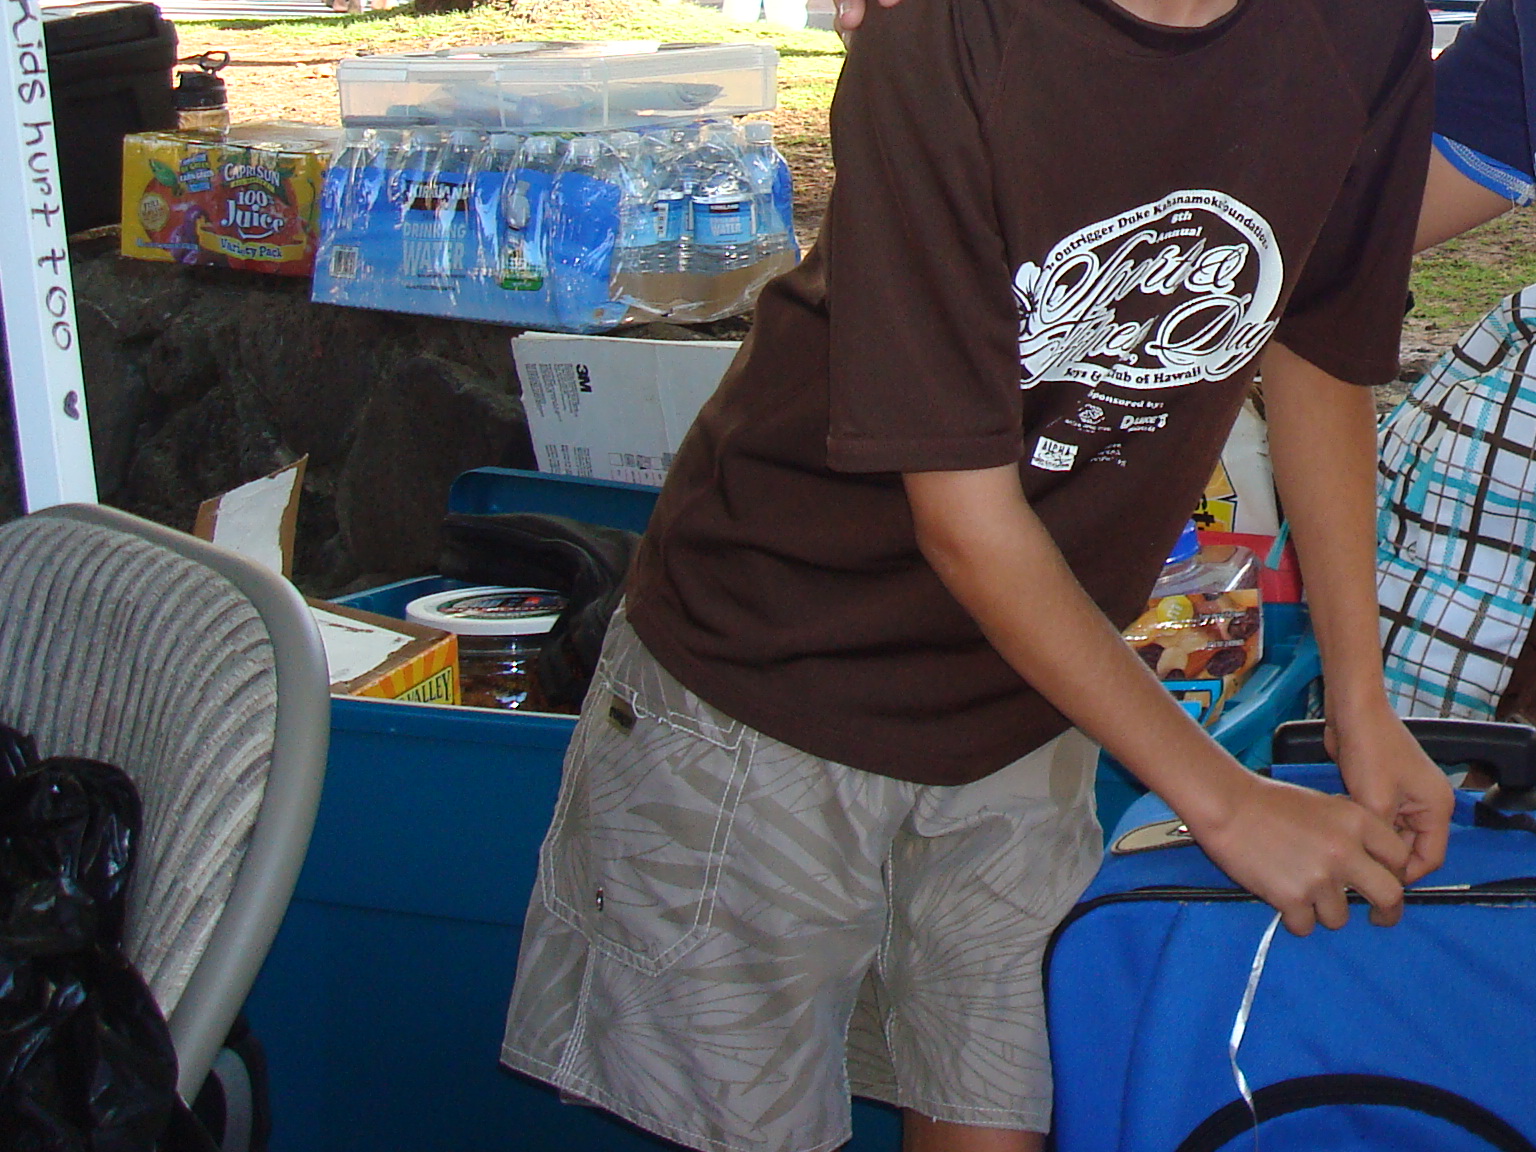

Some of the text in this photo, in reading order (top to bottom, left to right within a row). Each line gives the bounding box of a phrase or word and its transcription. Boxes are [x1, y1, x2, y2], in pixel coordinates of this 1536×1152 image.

[23, 120, 61, 228] hurt
[220, 199, 285, 233] Juice
[259, 246, 282, 258] Pack
[1055, 223, 1115, 262] Outrigger
[1117, 207, 1151, 228] Duke
[403, 240, 465, 277] WATER
[38, 247, 72, 352] too
[575, 363, 594, 394] 3M
[1135, 372, 1150, 385] of
